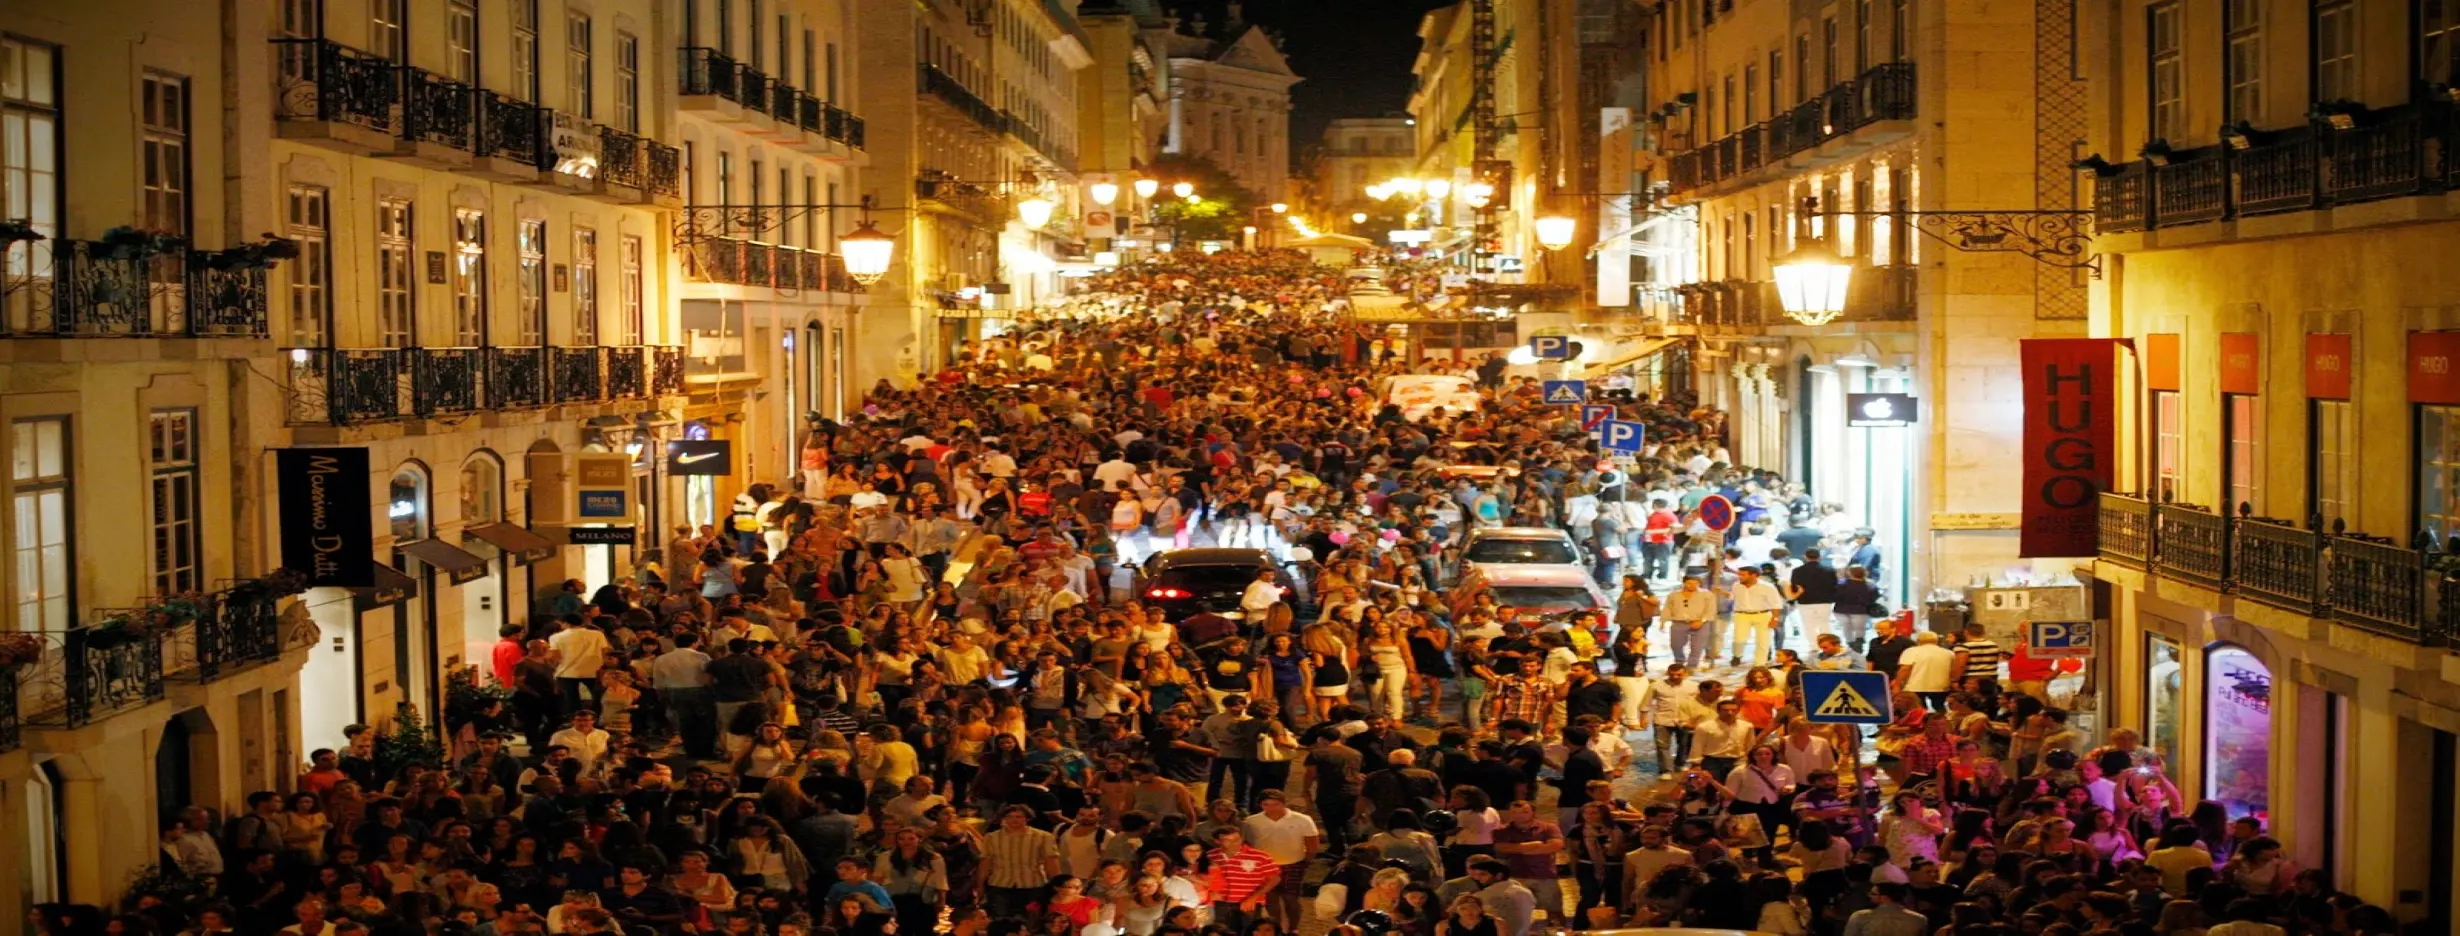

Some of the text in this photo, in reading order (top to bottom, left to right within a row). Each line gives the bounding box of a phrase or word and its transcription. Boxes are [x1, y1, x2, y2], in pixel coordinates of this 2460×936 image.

[1536, 337, 1560, 356] P
[2315, 354, 2340, 372] HUGO
[2419, 356, 2448, 374] HUGO
[1610, 423, 1634, 446] P
[2041, 364, 2095, 509] HUGO
[307, 455, 342, 579] Massimo Dutti
[576, 532, 632, 540] MILANO
[2038, 624, 2066, 647] P
